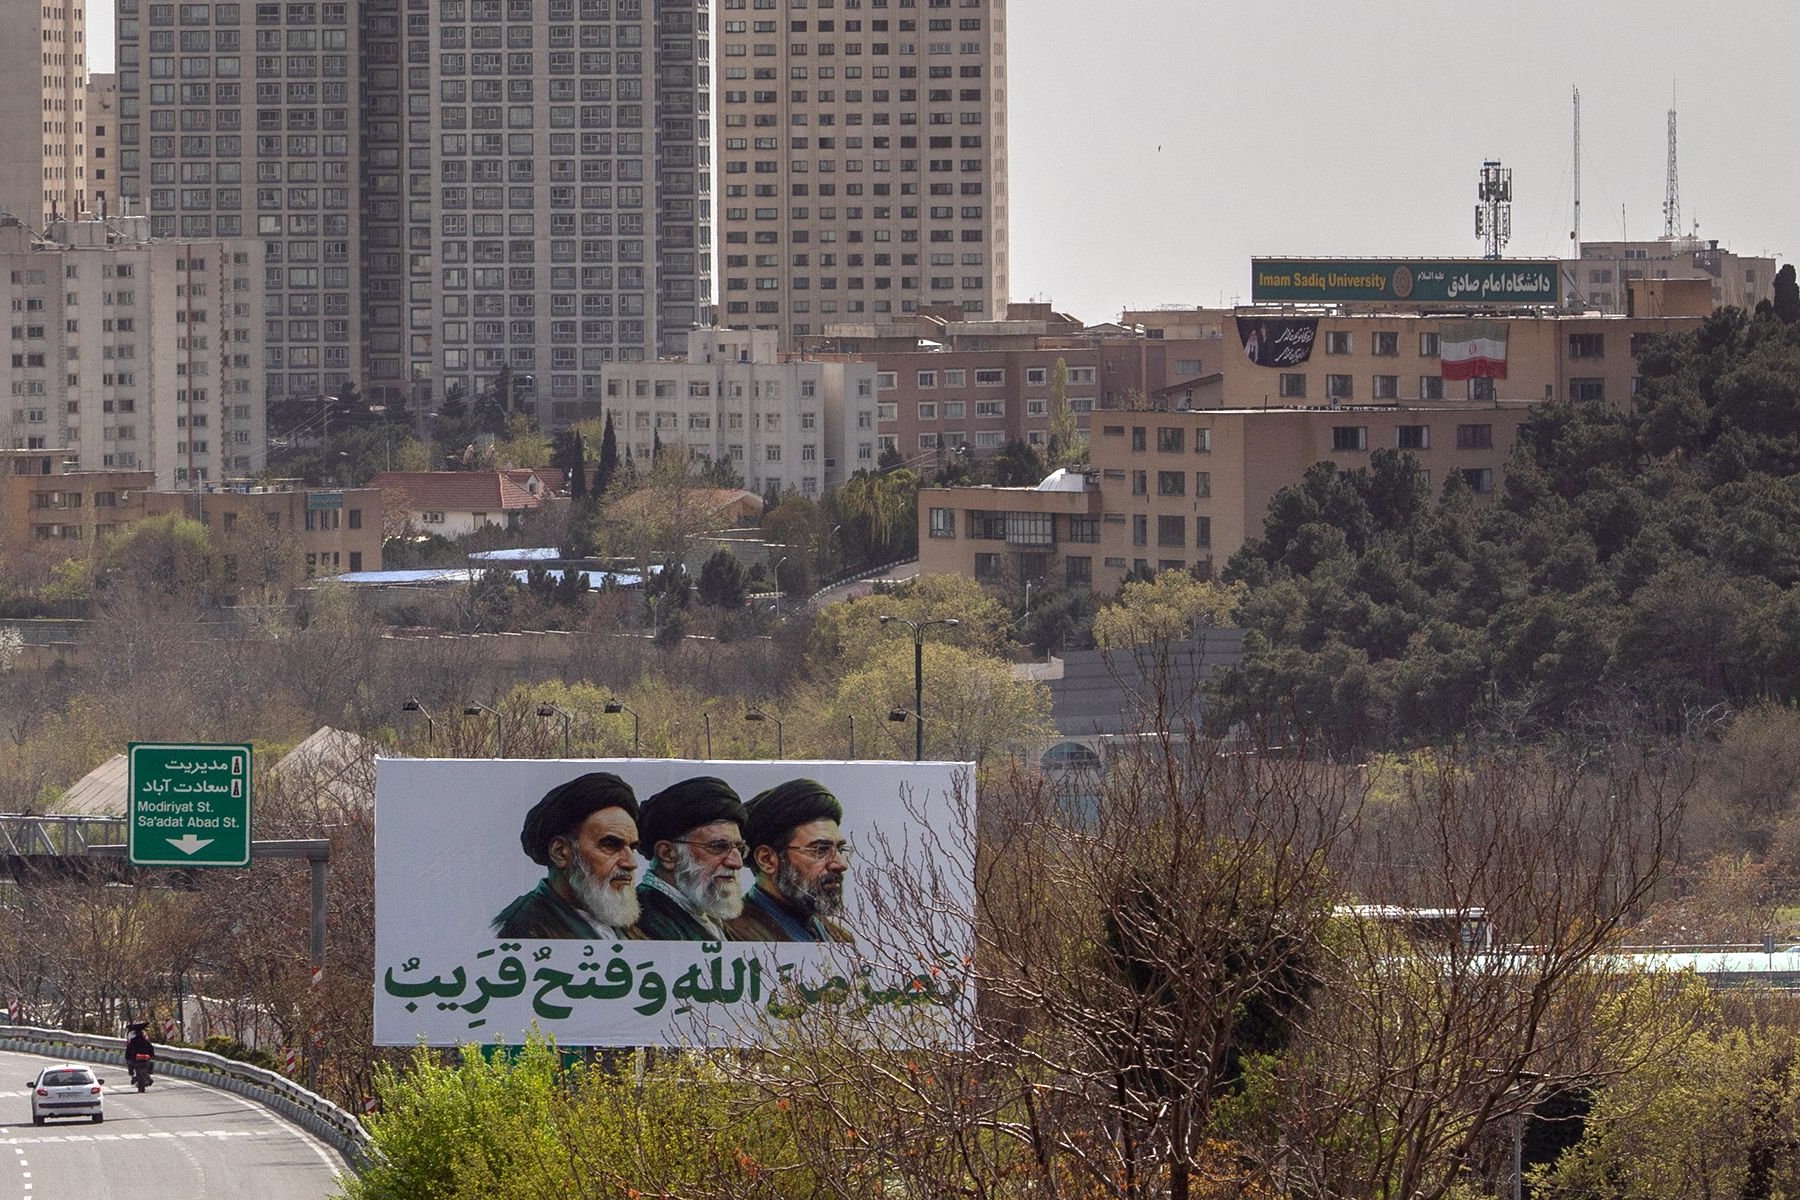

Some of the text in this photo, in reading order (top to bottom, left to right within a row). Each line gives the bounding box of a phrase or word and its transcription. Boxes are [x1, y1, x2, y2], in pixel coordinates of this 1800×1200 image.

[1259, 272, 1387, 291] Imam Sadiq University
[1447, 272, 1480, 298] صادق
[1482, 272, 1505, 298] امام
[1506, 272, 1551, 293] دانشگاه
[164, 760, 229, 774] مدیریت
[142, 778, 229, 795] سعادت آباد
[137, 801, 214, 814] Modiriyat St.
[138, 816, 240, 828] Sa'adat Abad St.
